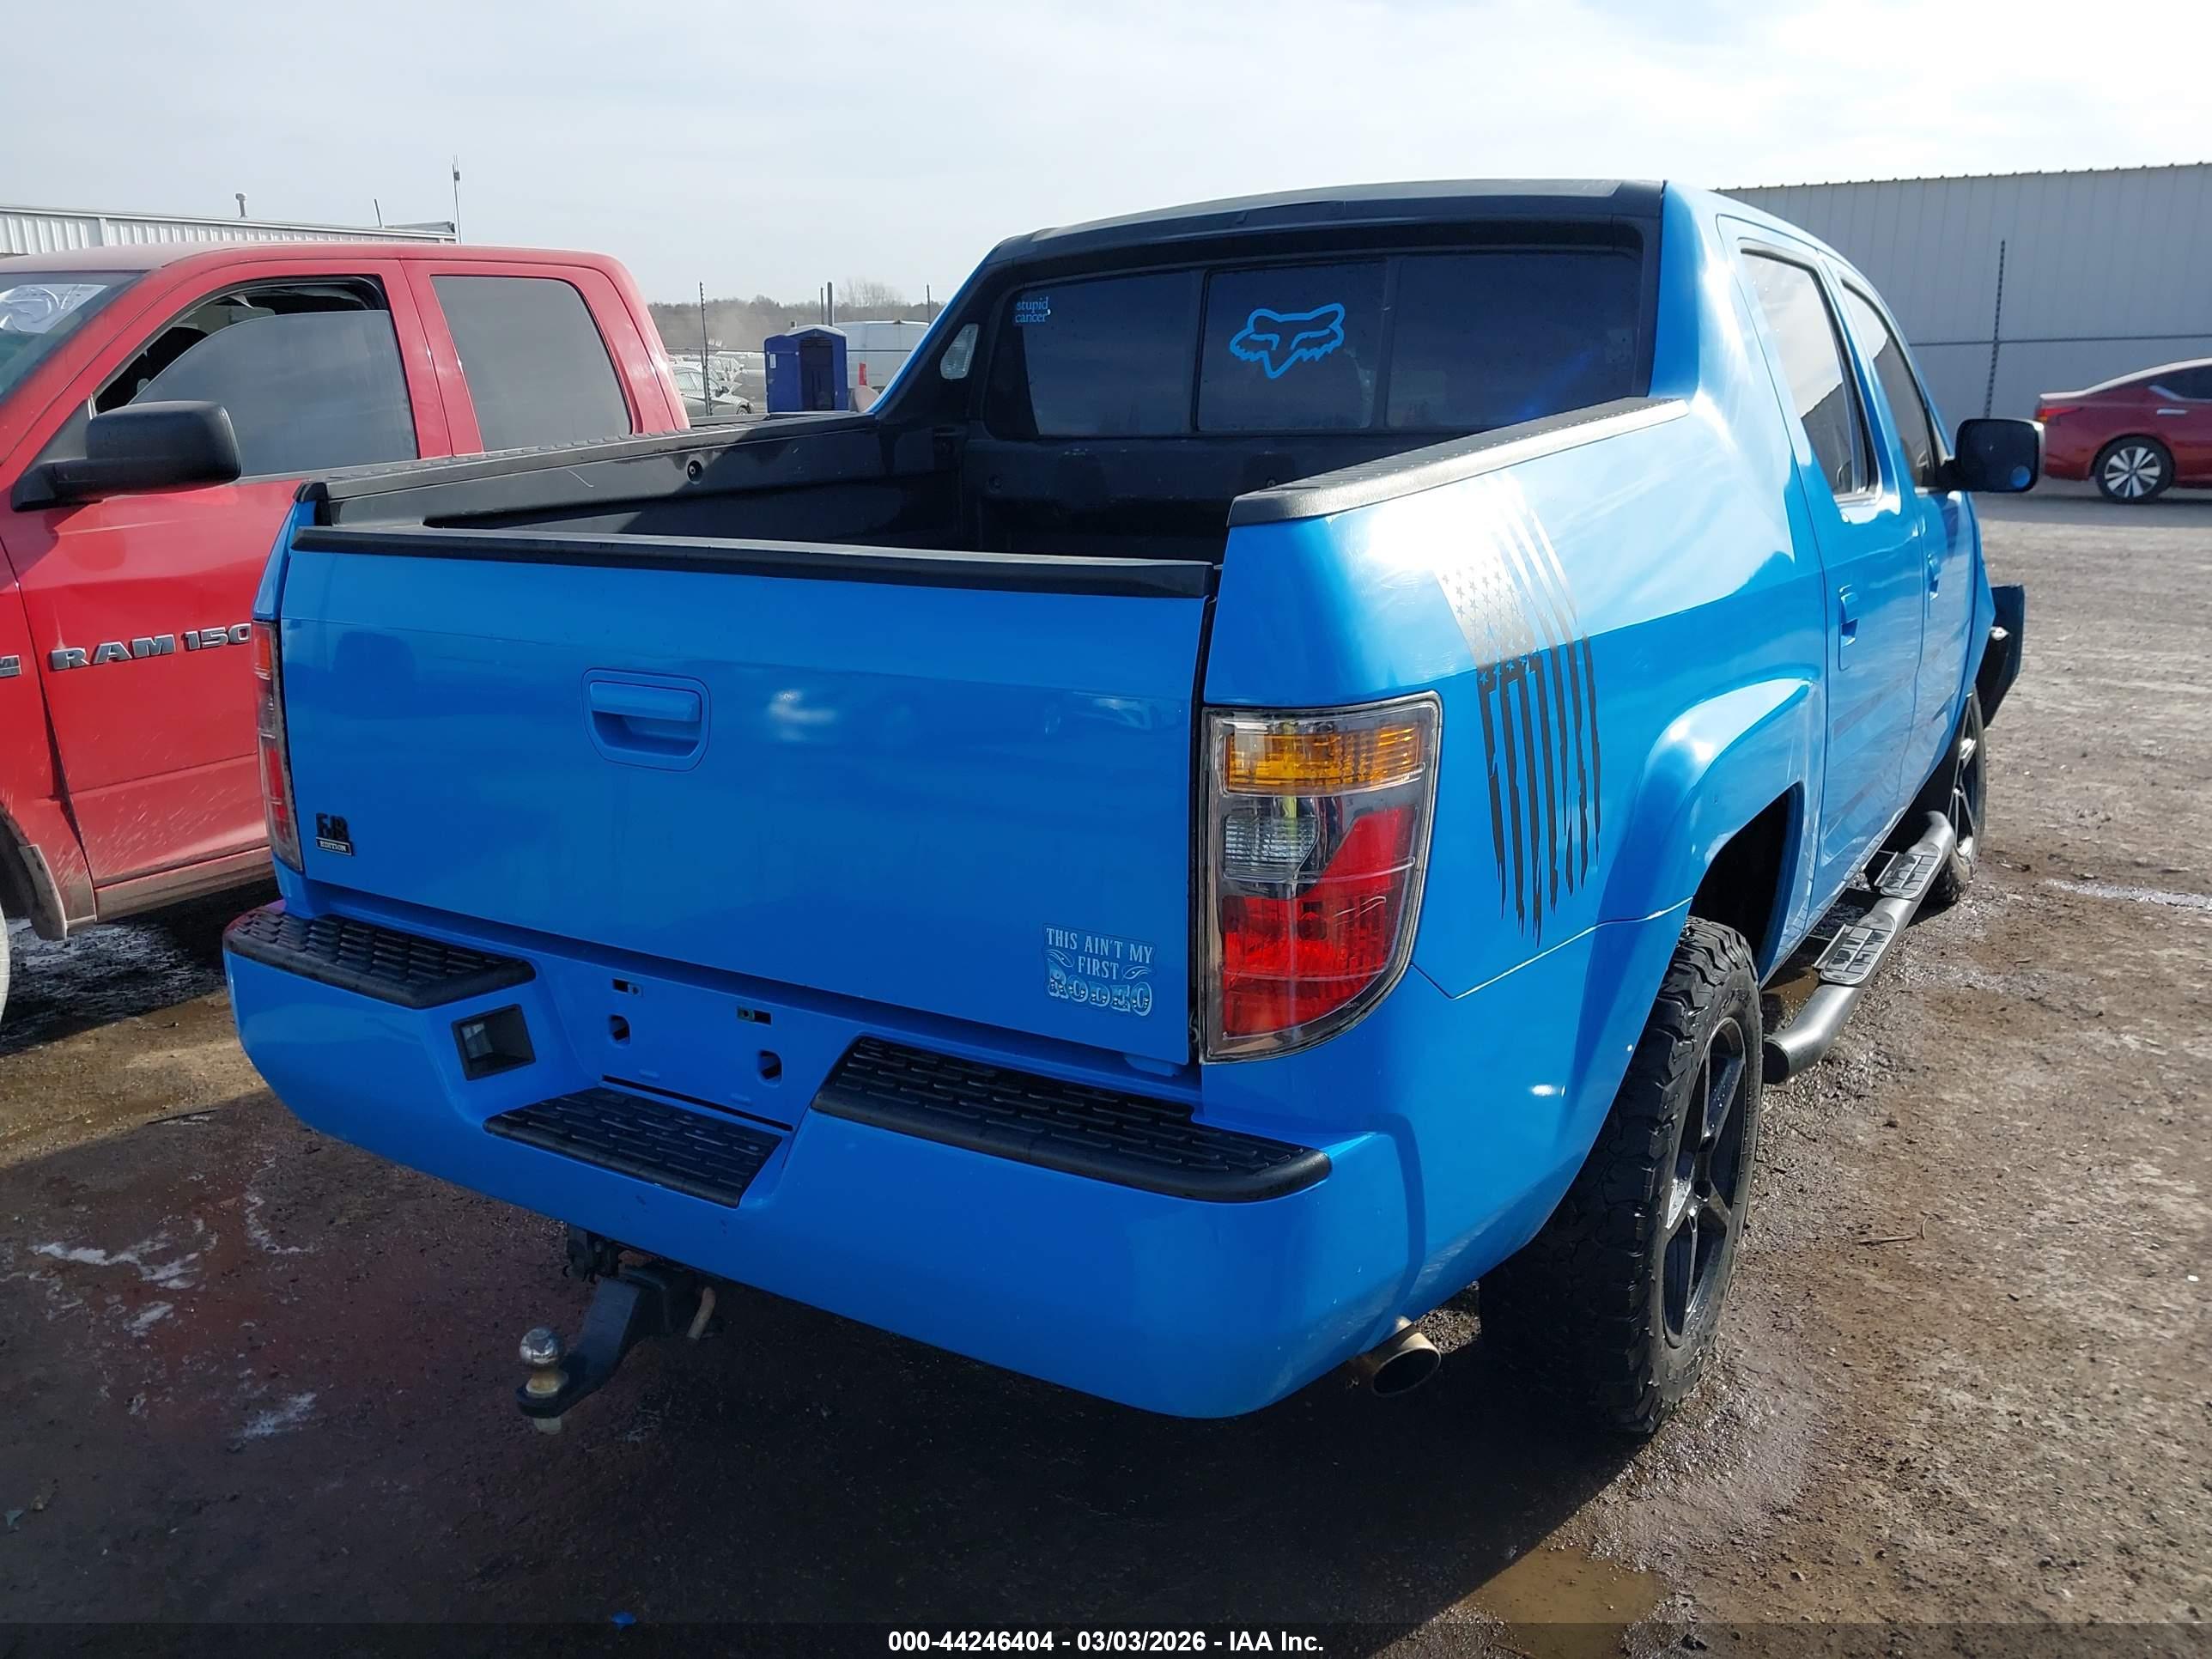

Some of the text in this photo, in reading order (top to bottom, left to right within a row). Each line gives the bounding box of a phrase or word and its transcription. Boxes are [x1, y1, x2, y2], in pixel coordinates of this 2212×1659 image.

[1015, 311, 1047, 323] cancer
[51, 634, 176, 671] RAM
[319, 840, 347, 852] EDITION
[1046, 927, 1153, 964] THIS AIN'T MY
[1078, 956, 1120, 980] FIRST
[1047, 958, 1153, 1017] RODEO
